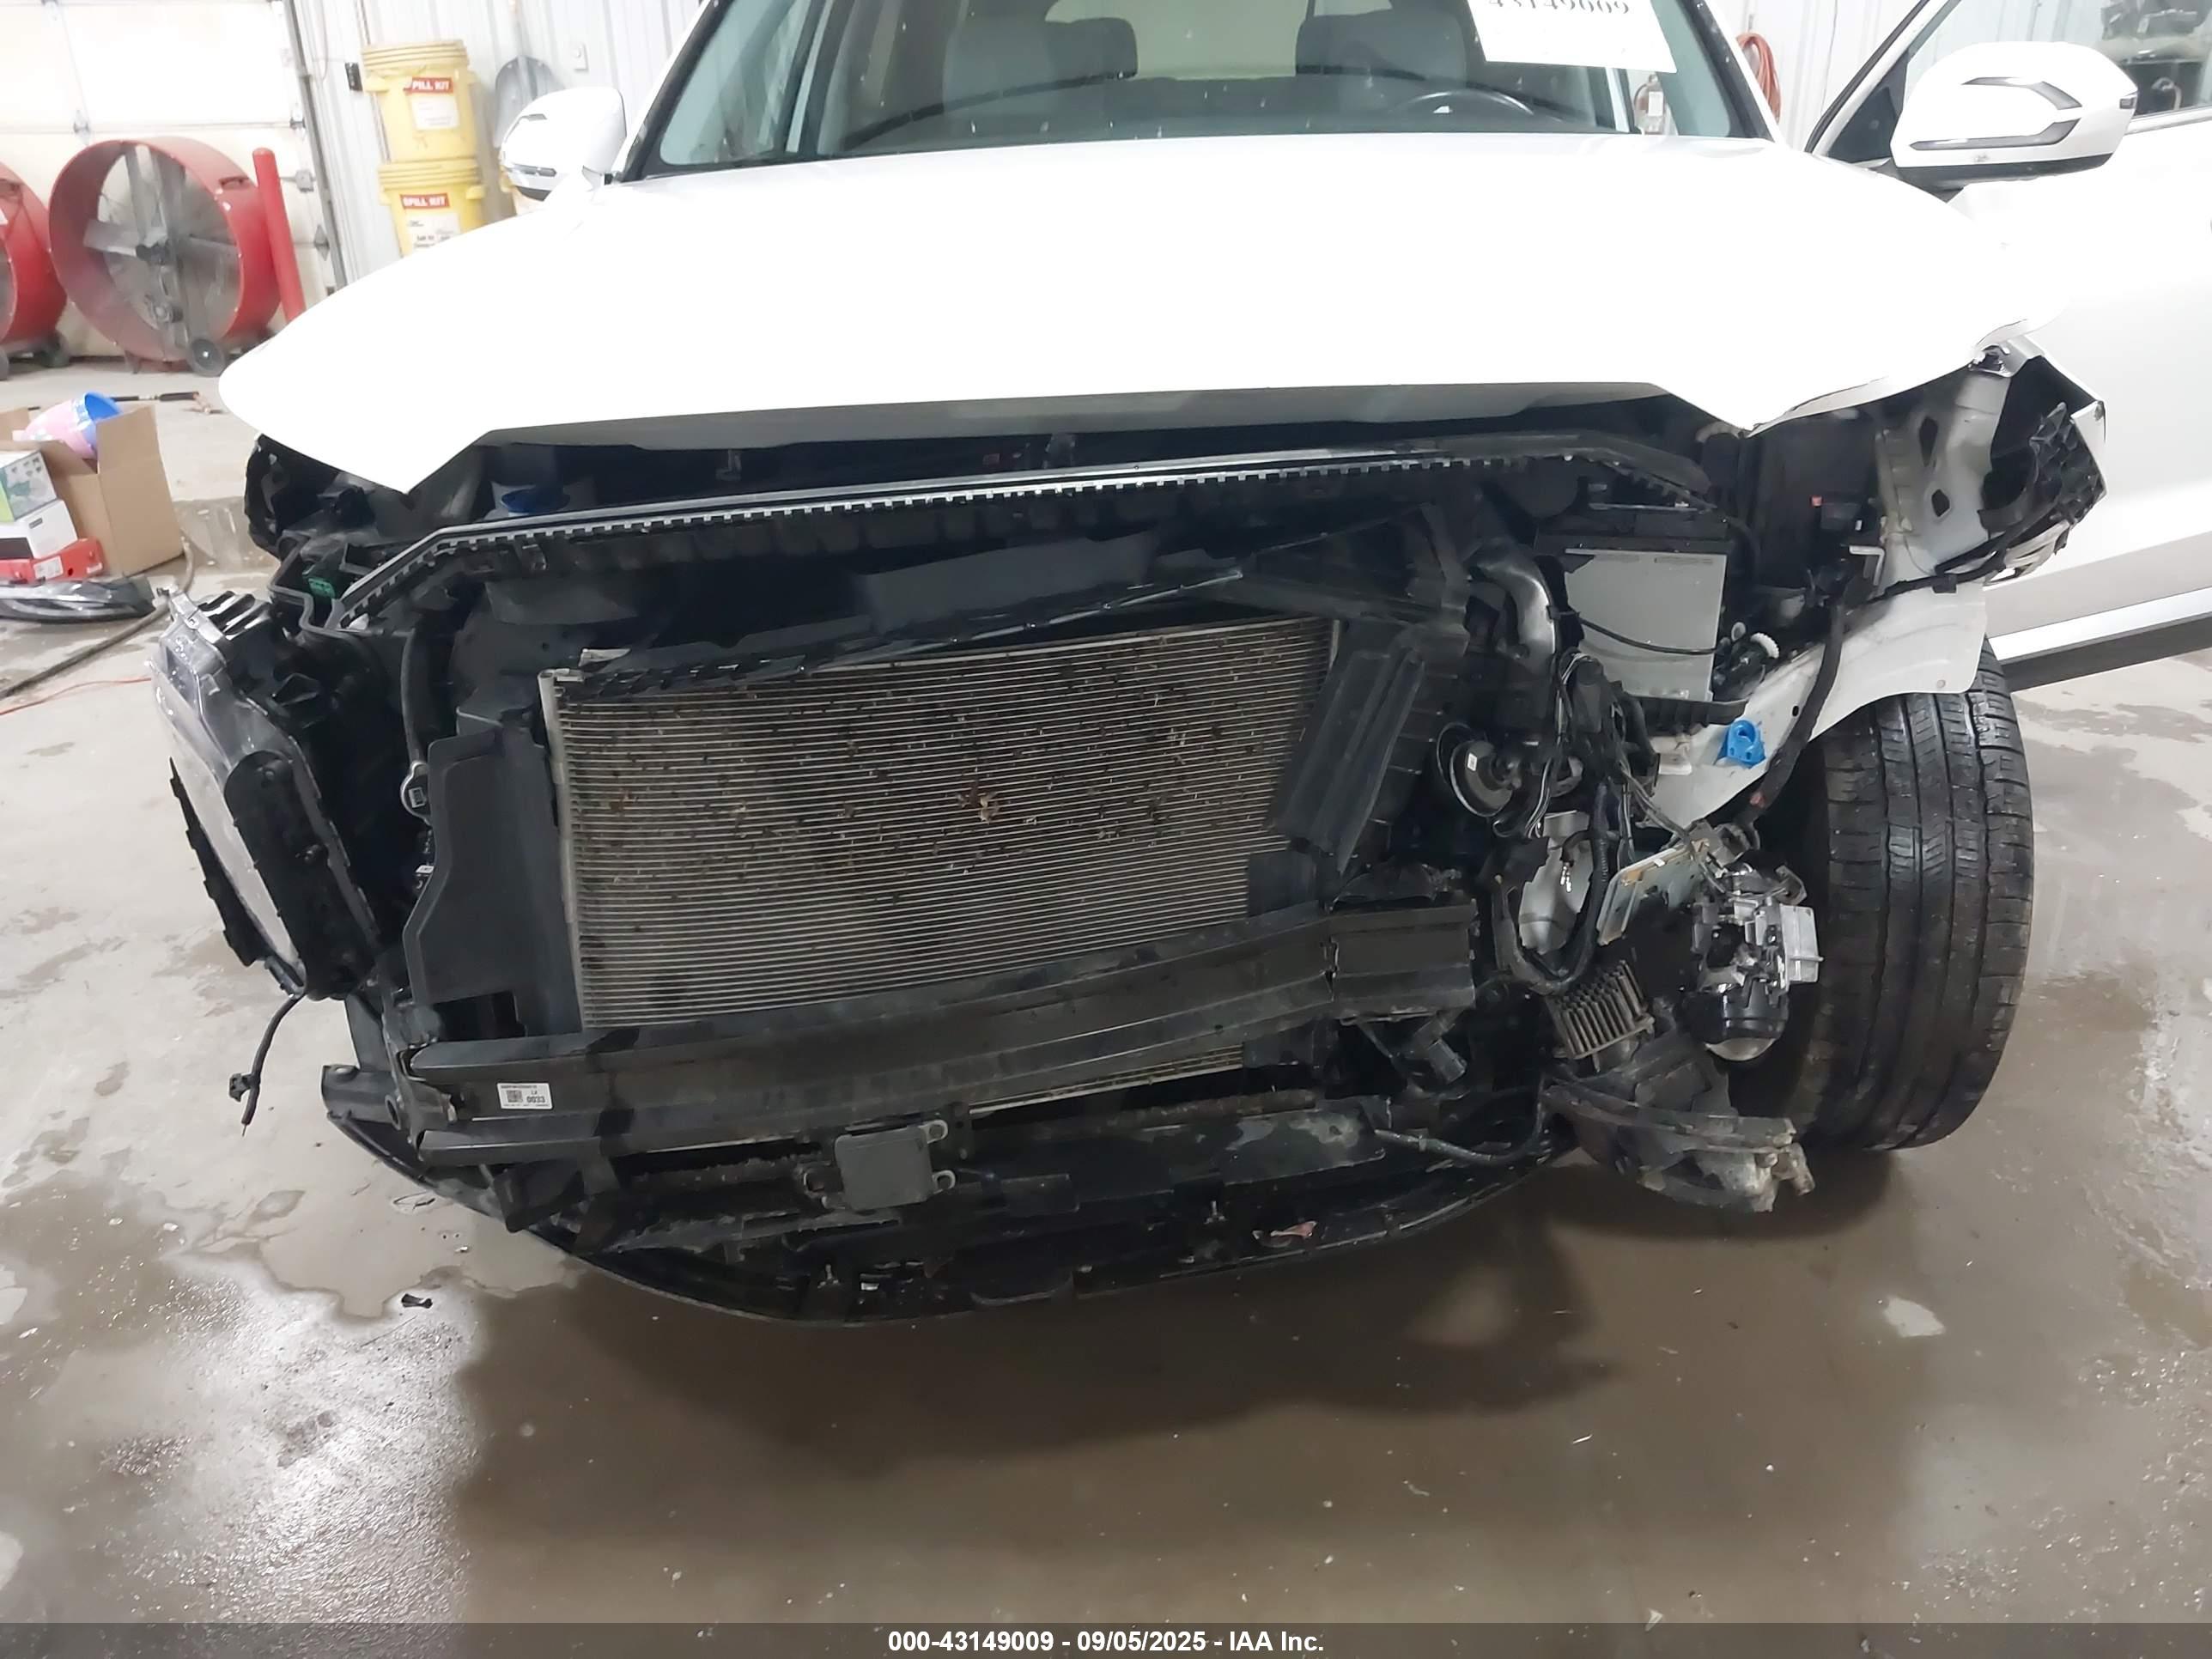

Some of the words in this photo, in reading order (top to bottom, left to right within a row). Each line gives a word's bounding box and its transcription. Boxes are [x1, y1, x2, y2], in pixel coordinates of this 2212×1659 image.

[434, 81, 450, 90] KIT
[403, 196, 428, 207] SPILL
[428, 195, 446, 207] KIT
